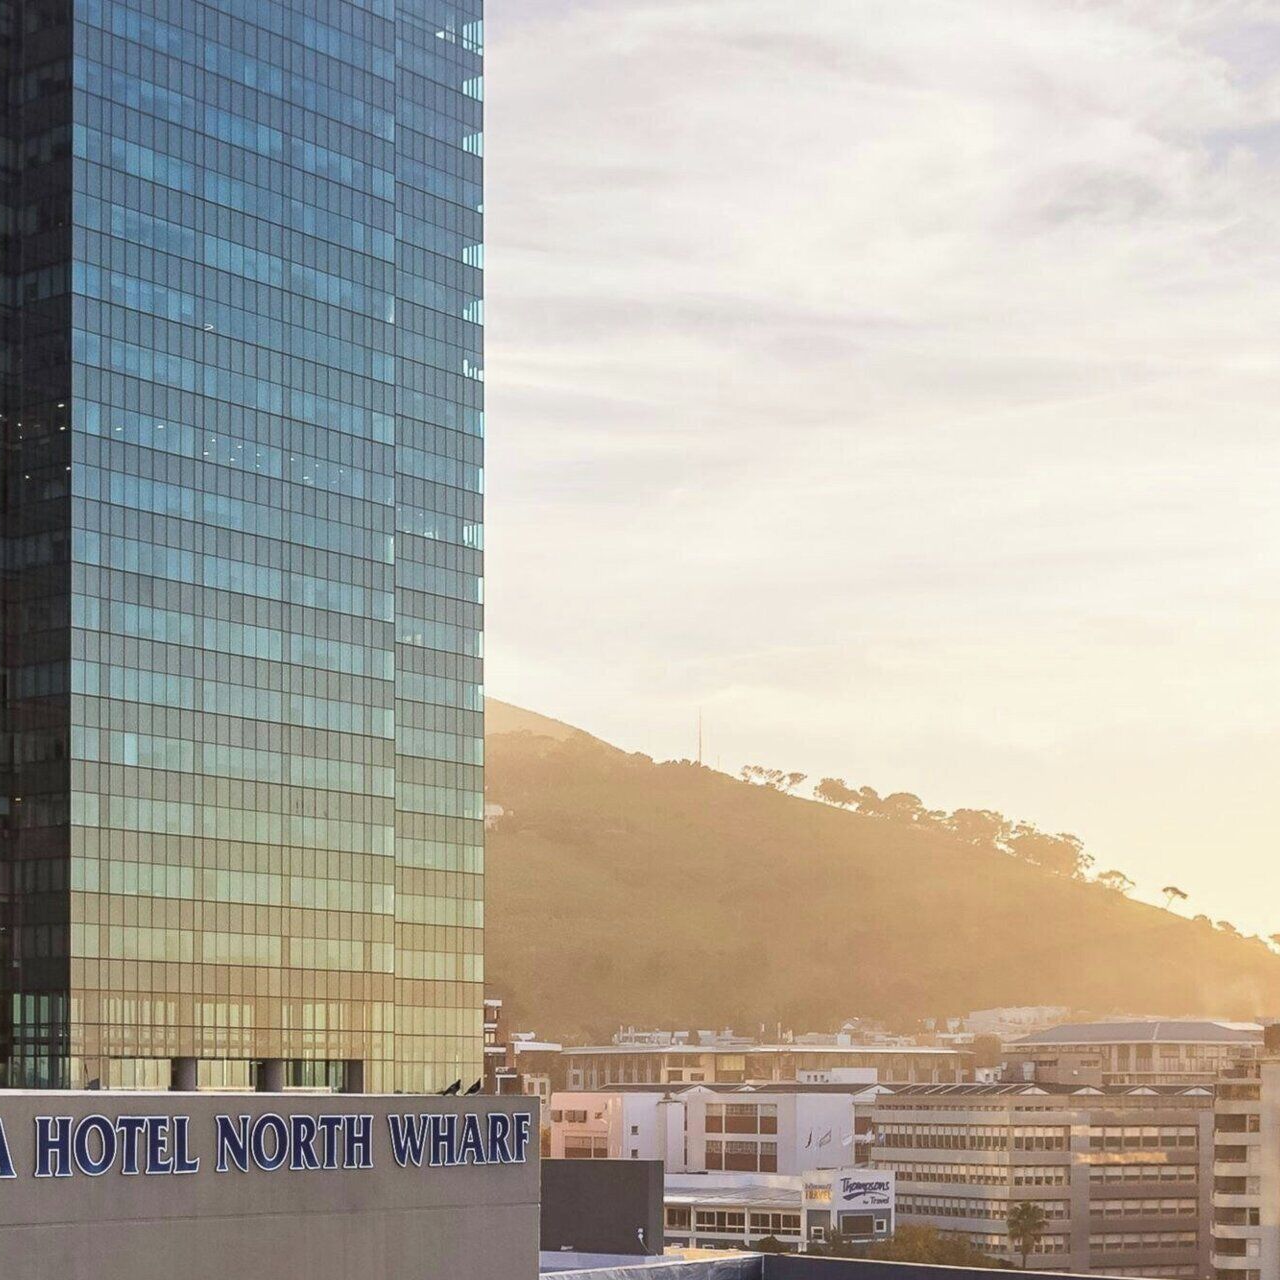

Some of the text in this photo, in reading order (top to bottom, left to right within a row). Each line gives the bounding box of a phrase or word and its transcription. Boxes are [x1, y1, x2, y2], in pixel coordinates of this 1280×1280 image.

[34, 1114, 200, 1178] HOTEL
[215, 1112, 375, 1173] NORTH
[387, 1112, 532, 1168] WHARF
[840, 1177, 890, 1195] Thompsons
[870, 1196, 890, 1205] Travel
